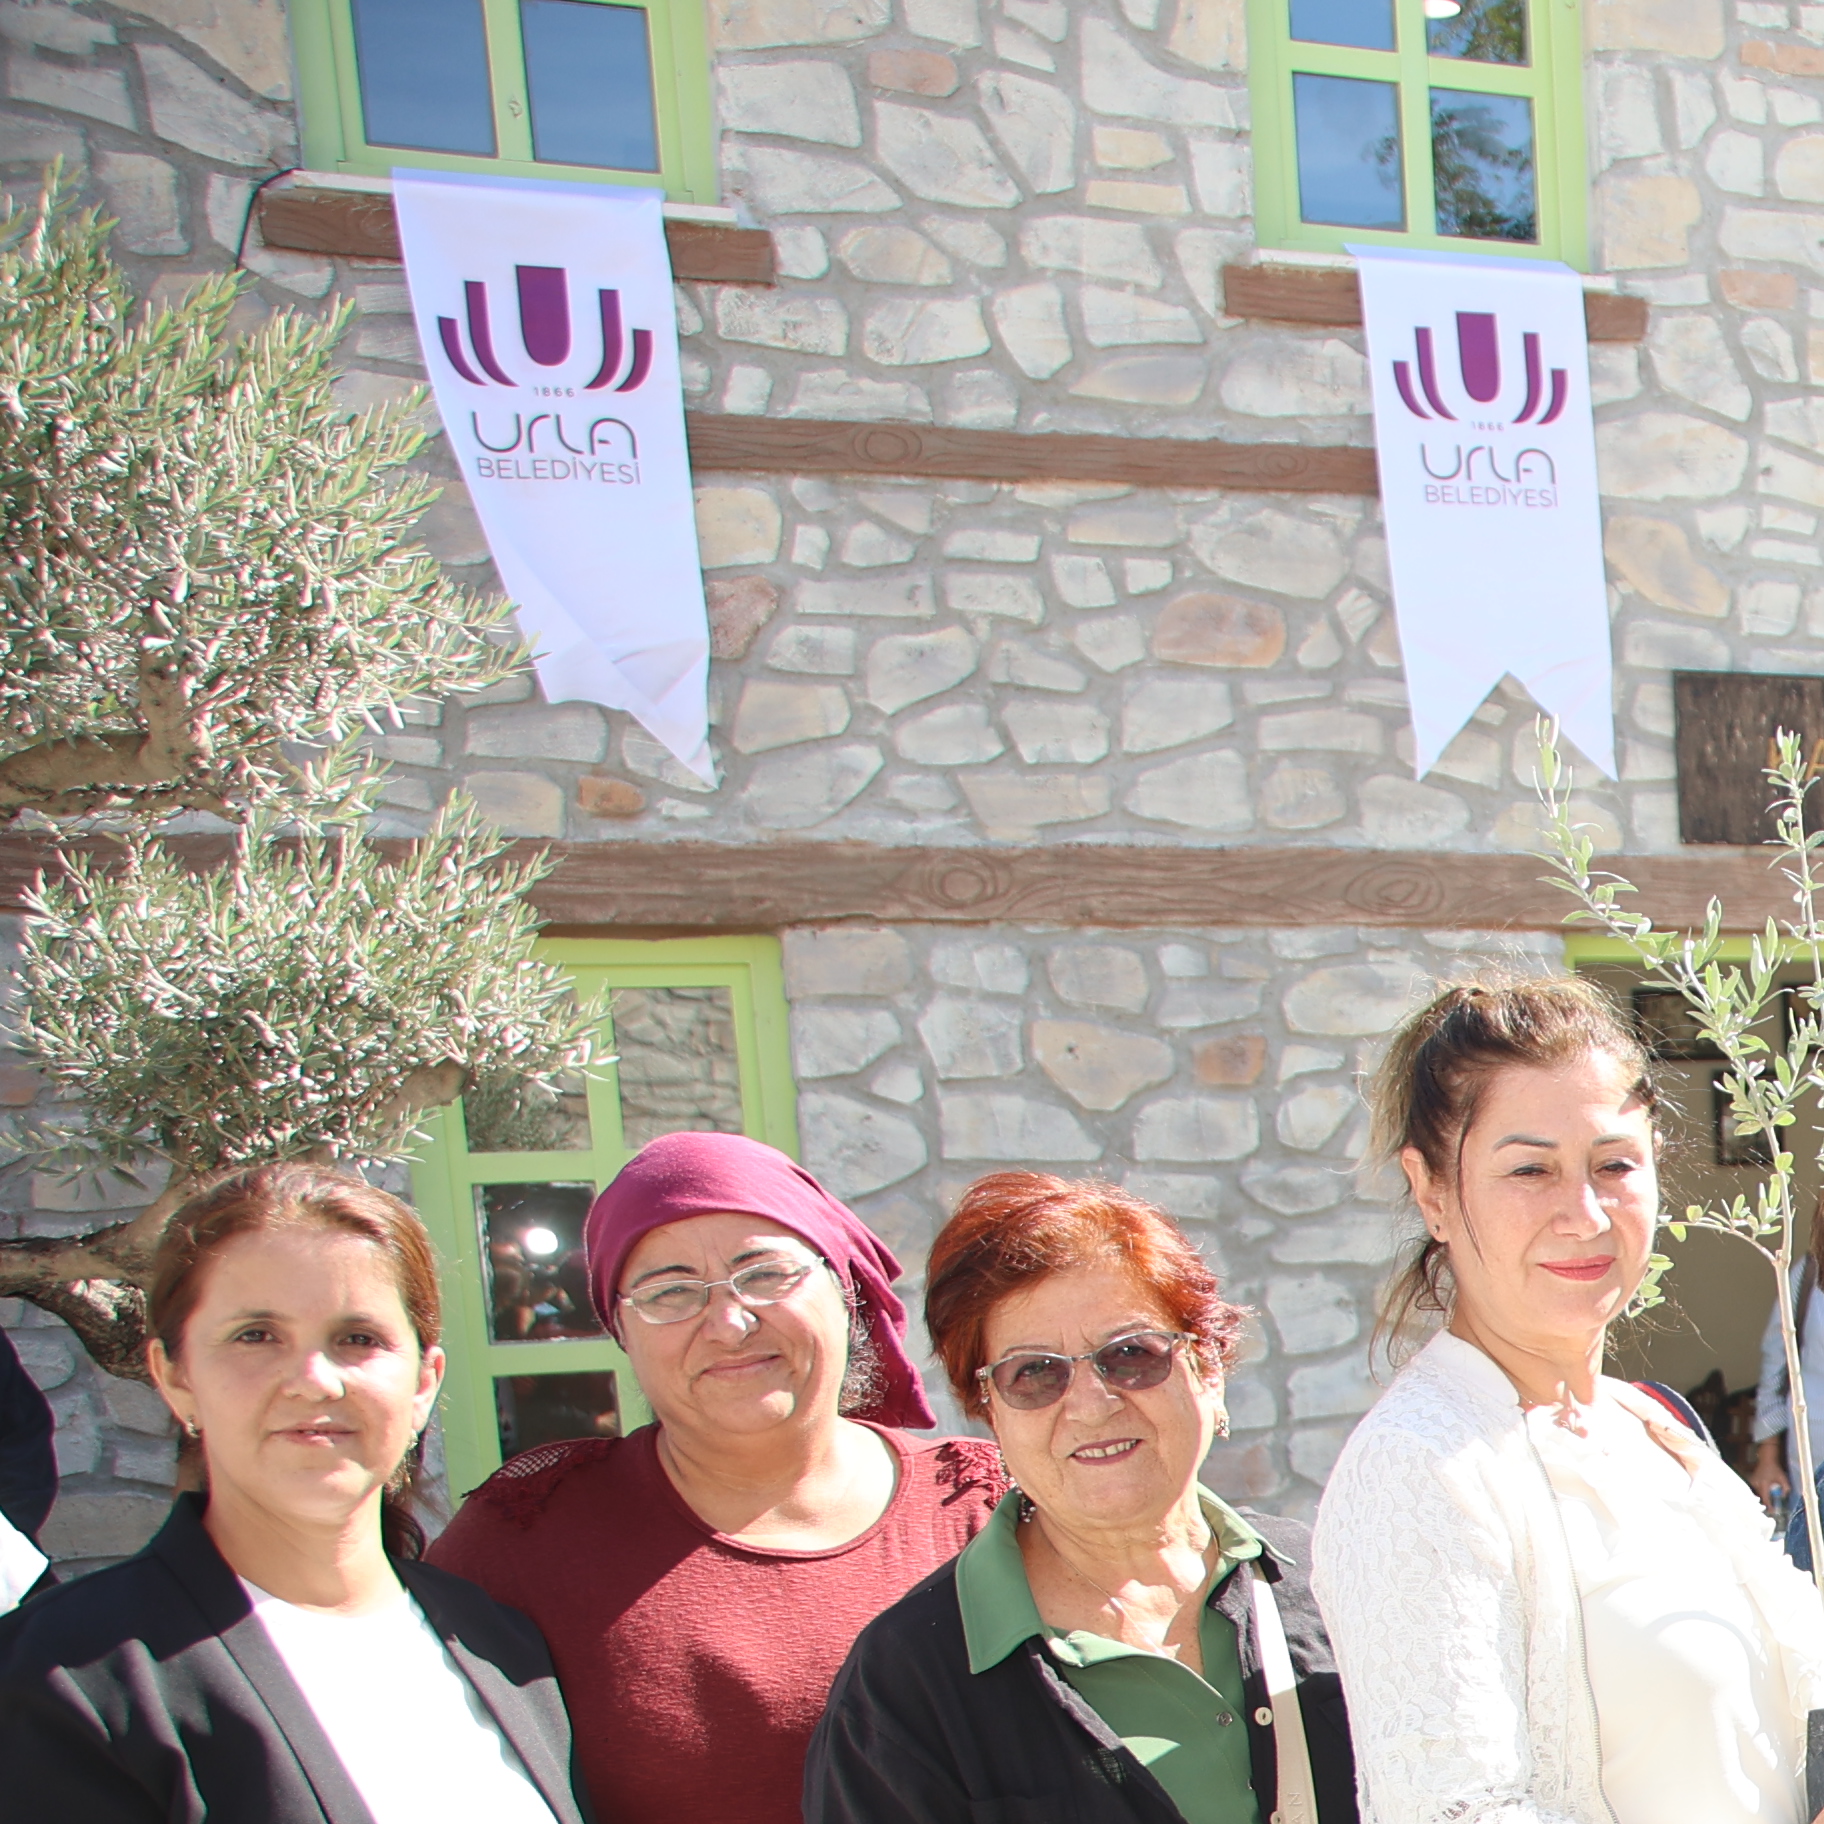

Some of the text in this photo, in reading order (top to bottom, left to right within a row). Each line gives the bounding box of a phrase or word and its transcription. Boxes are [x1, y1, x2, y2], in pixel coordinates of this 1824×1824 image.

[533, 386, 576, 398] 1866
[476, 456, 642, 485] BELEDİYESİ
[1424, 484, 1559, 508] BELEDİYESİ
